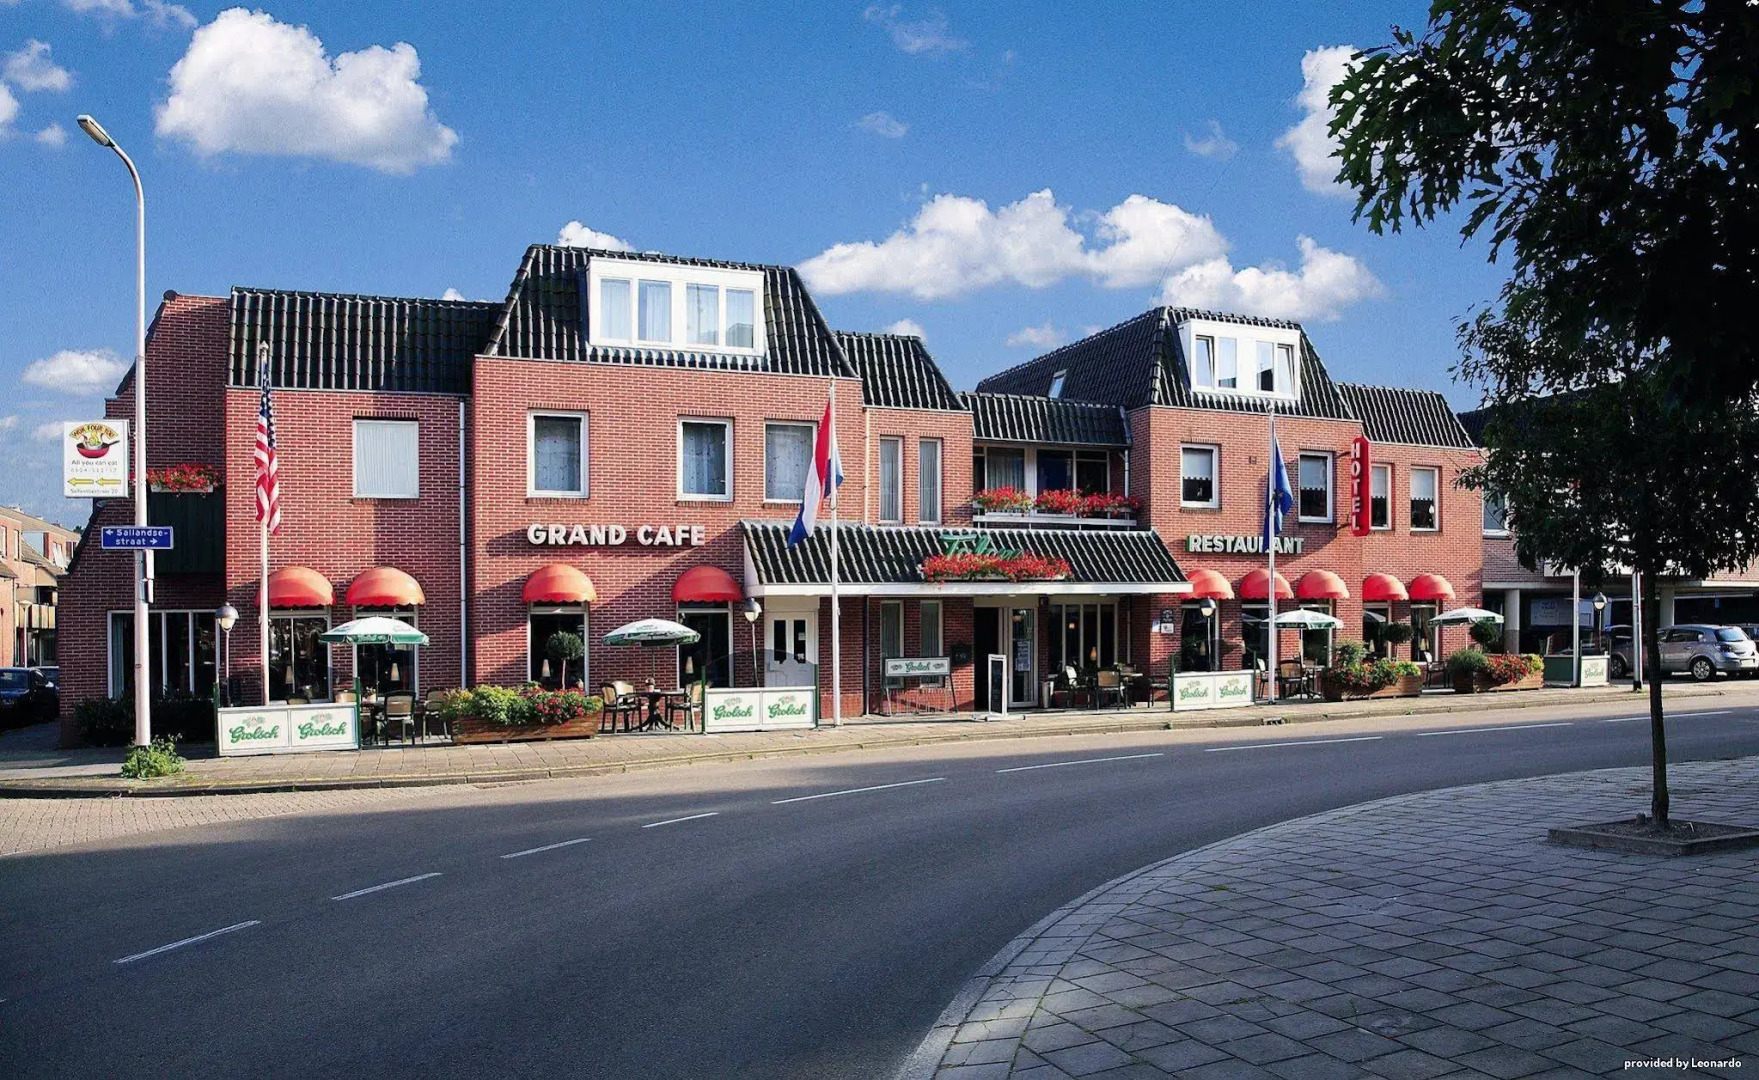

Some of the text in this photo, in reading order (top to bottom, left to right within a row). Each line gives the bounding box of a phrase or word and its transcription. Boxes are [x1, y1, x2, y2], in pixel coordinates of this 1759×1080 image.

[1350, 441, 1365, 531] HOTEL
[115, 537, 147, 545] straat
[116, 528, 169, 537] Sallandse-
[526, 523, 706, 546] GRAND CAFE
[1187, 534, 1305, 554] RESTAUANT
[905, 661, 931, 673] Grolsch
[1178, 685, 1209, 701] Grolsch
[1218, 682, 1248, 699] Grolsch
[712, 704, 754, 721] Grolsch
[767, 701, 808, 720] Grolsch
[229, 725, 279, 743] Grolsch
[298, 722, 347, 740] Grolsch
